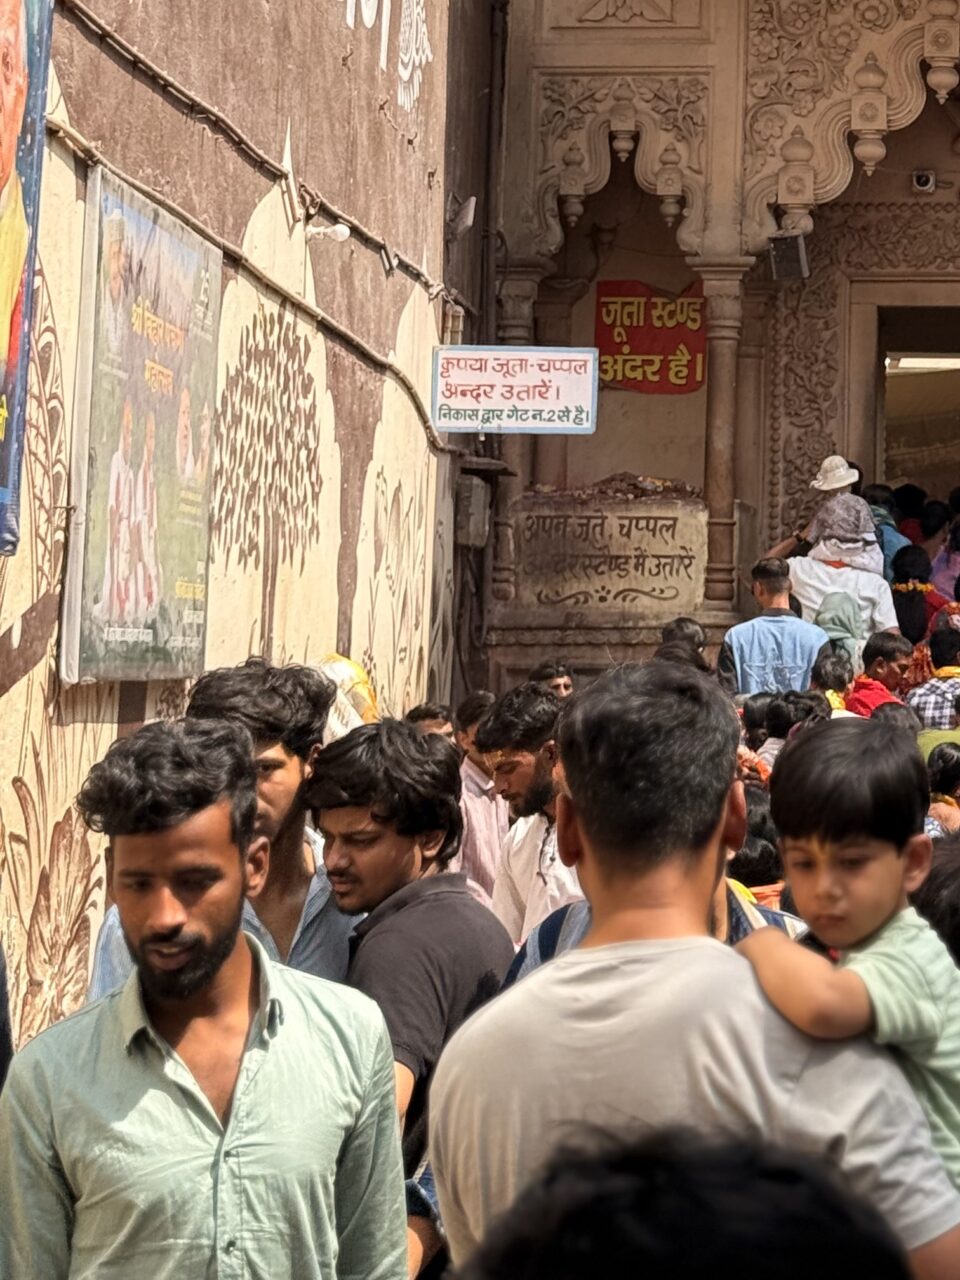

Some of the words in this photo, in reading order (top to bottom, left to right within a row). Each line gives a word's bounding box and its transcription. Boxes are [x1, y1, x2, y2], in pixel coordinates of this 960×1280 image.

[601, 296, 647, 343] जूता
[600, 343, 664, 382] अंदर
[441, 381, 496, 404] अन्दर
[438, 403, 479, 421] निकास
[480, 408, 504, 424] द्वार
[506, 404, 530, 421] गेट
[617, 515, 679, 544] चप्पल
[633, 546, 649, 577] में
[649, 546, 696, 580] उतारें
